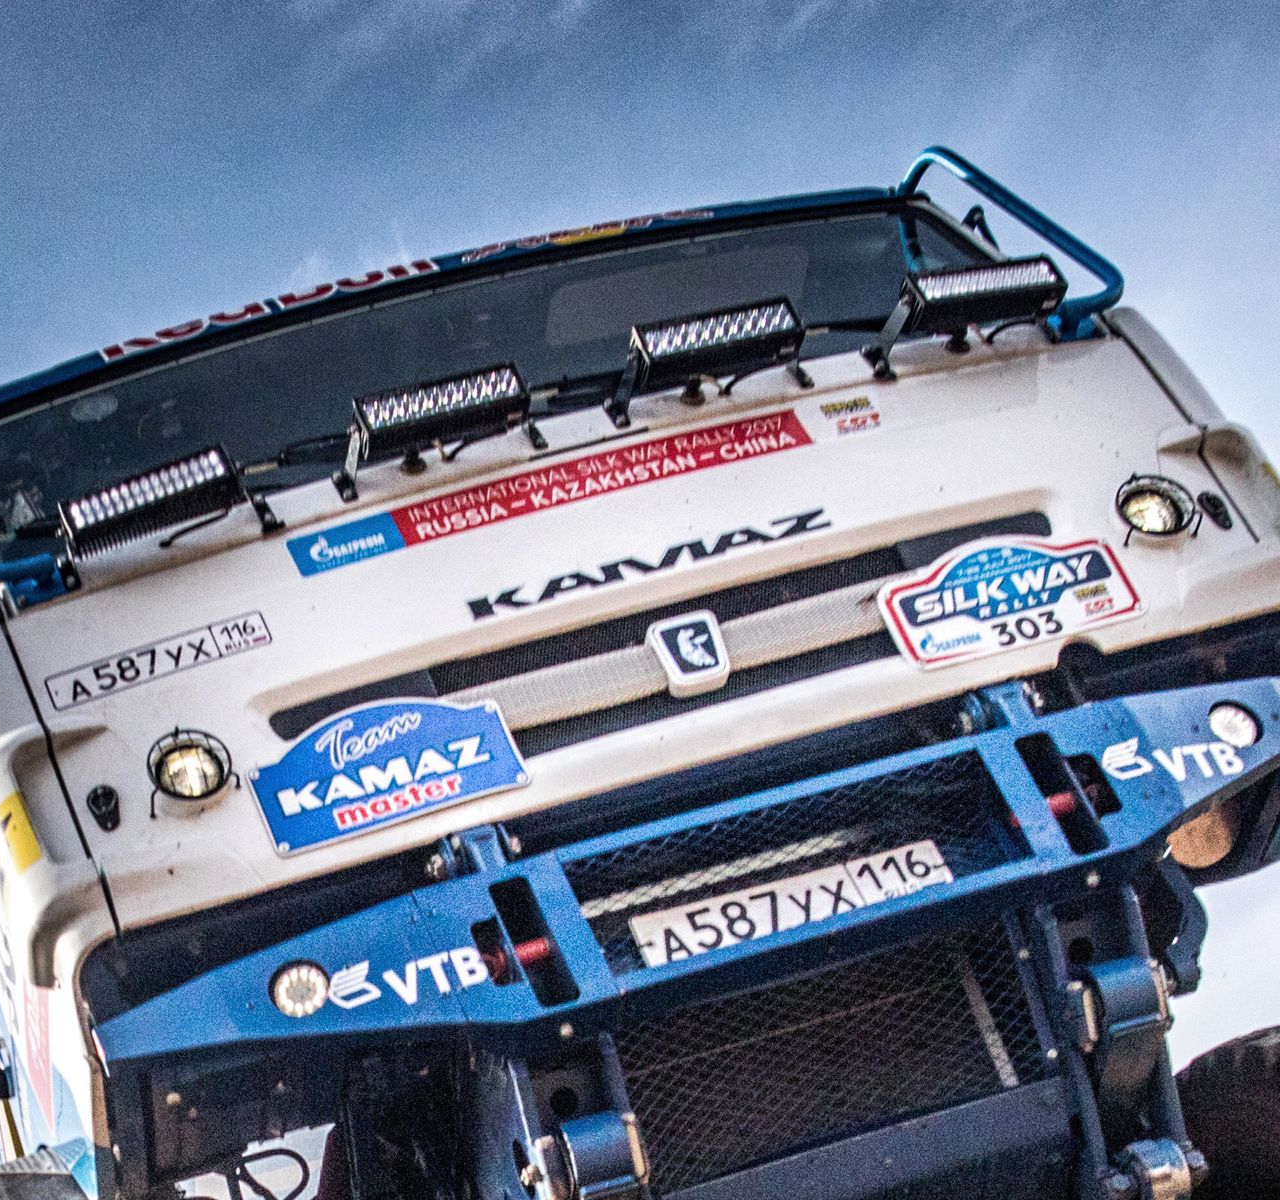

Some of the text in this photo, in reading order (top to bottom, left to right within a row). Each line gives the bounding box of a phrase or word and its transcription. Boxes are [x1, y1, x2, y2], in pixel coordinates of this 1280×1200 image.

[408, 415, 782, 523] INTERNATIONAL SILK WAY RALLY 2017
[416, 502, 508, 540] RUSSIA
[530, 452, 697, 510] KAZAKHSTAN
[720, 431, 797, 461] CHINA
[466, 507, 832, 620] KAMAZ
[913, 576, 1009, 623] SILK
[1011, 553, 1095, 596] WAY
[220, 618, 256, 642] 116
[978, 590, 1051, 619] RALLY
[991, 610, 1063, 647] 303
[314, 712, 422, 770] Team
[1150, 740, 1245, 783] VTB
[276, 735, 491, 817] KAMAZ
[333, 773, 463, 829] master
[856, 849, 932, 889] 116
[381, 945, 489, 1006] VTB
